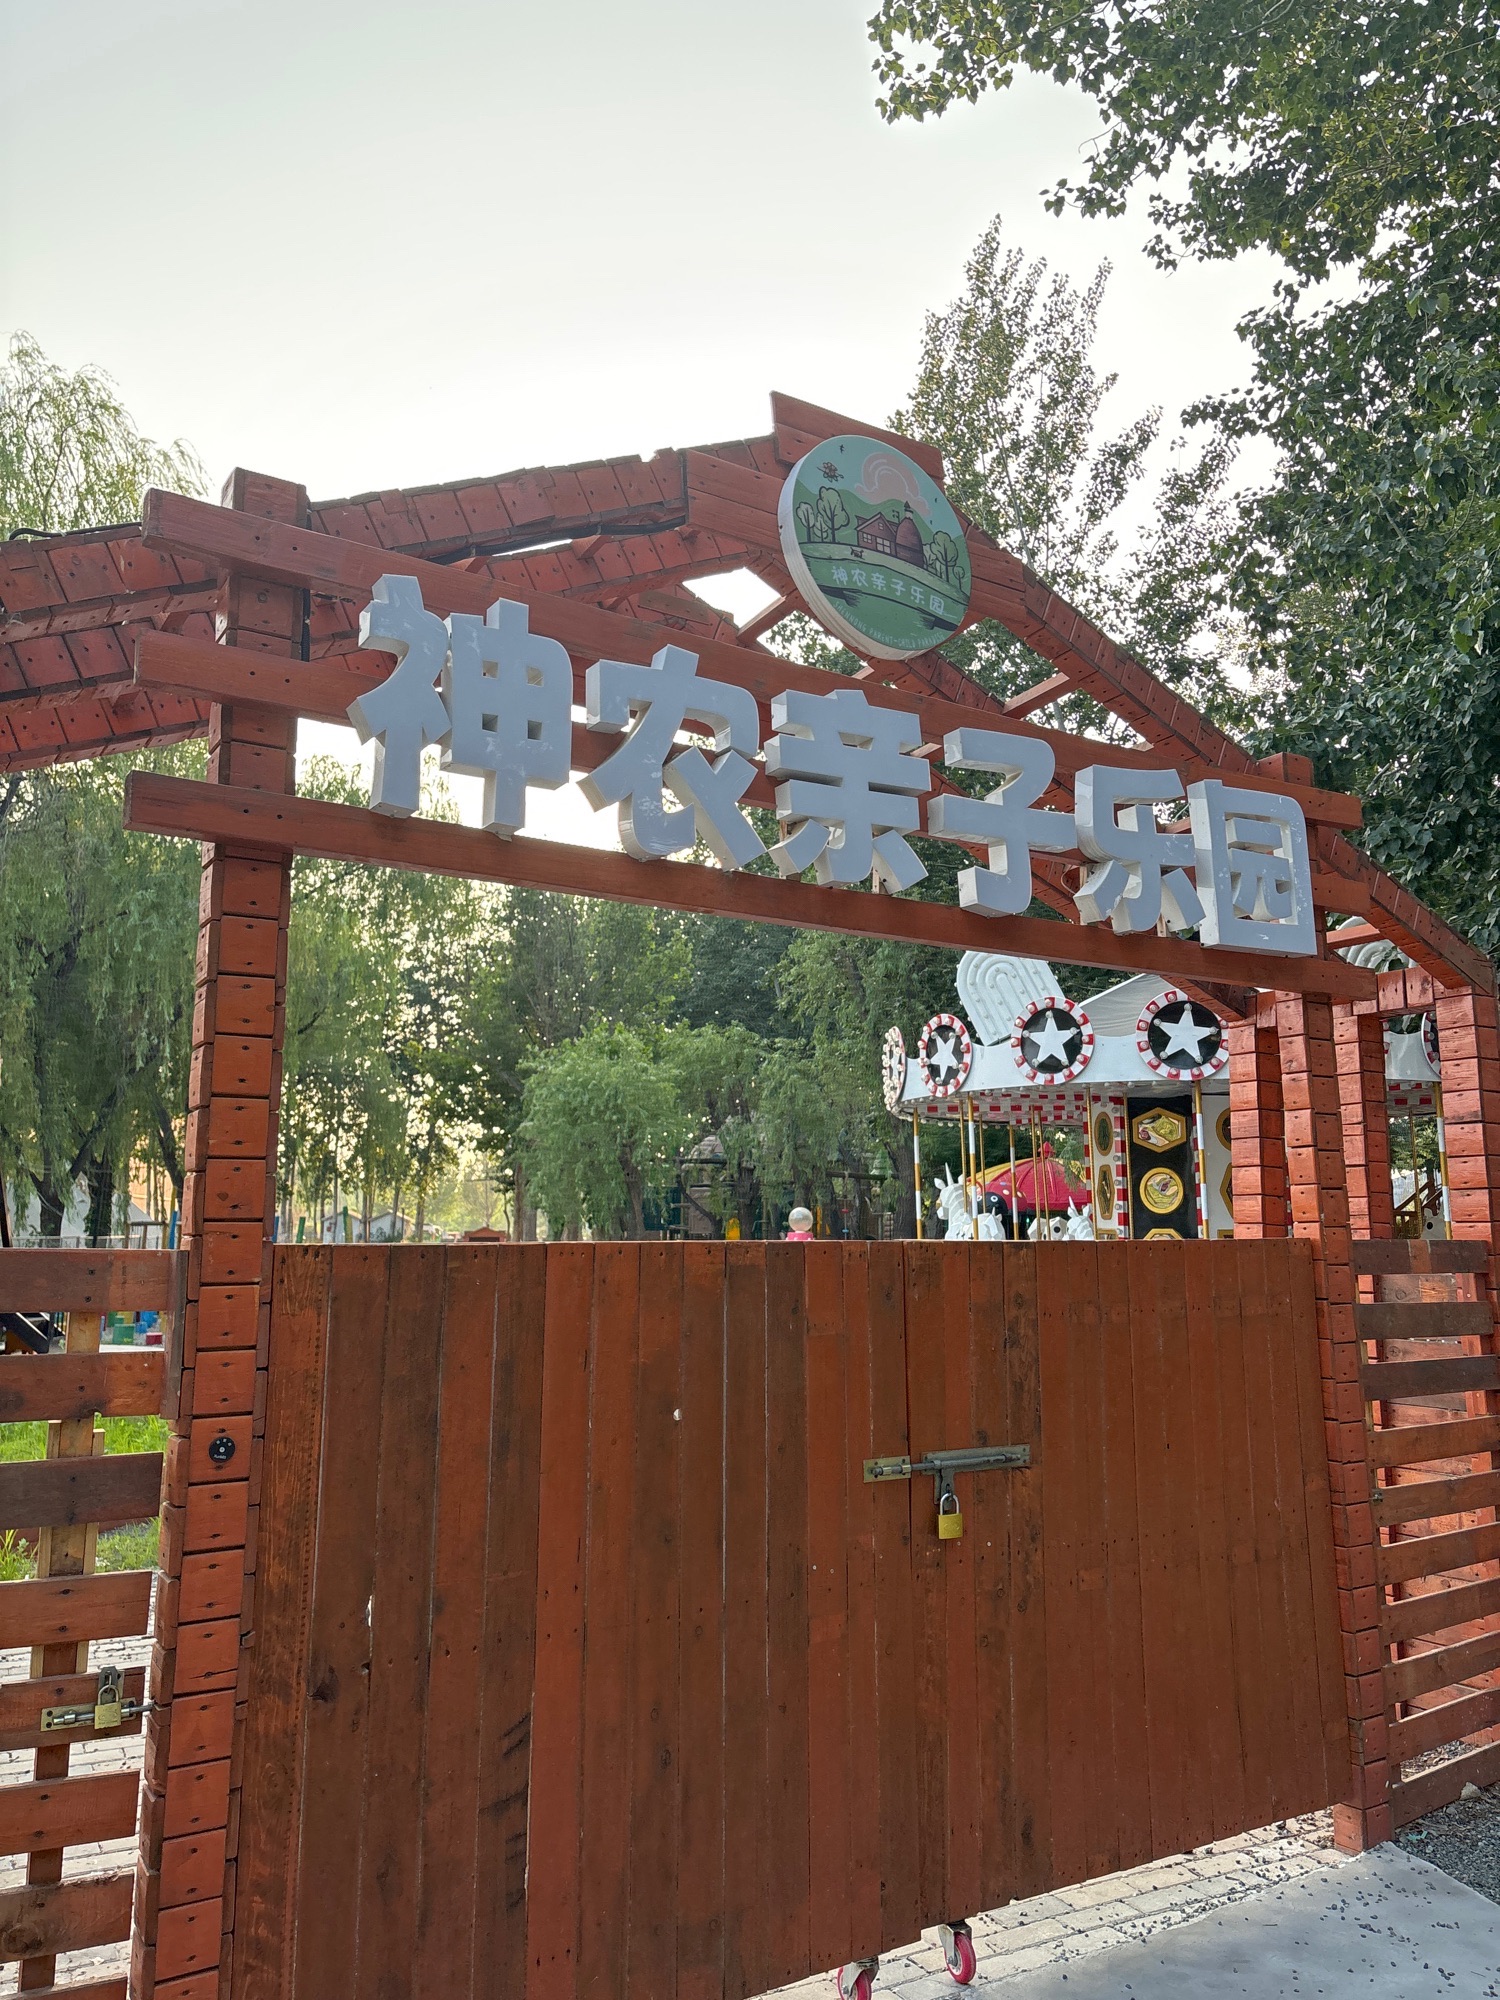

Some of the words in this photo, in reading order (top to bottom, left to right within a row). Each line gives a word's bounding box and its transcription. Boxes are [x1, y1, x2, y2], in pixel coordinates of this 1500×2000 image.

[832, 566, 944, 614] 神农亲子乐园
[834, 601, 867, 632] SHENNONG
[346, 574, 1316, 957] 神农亲子乐园
